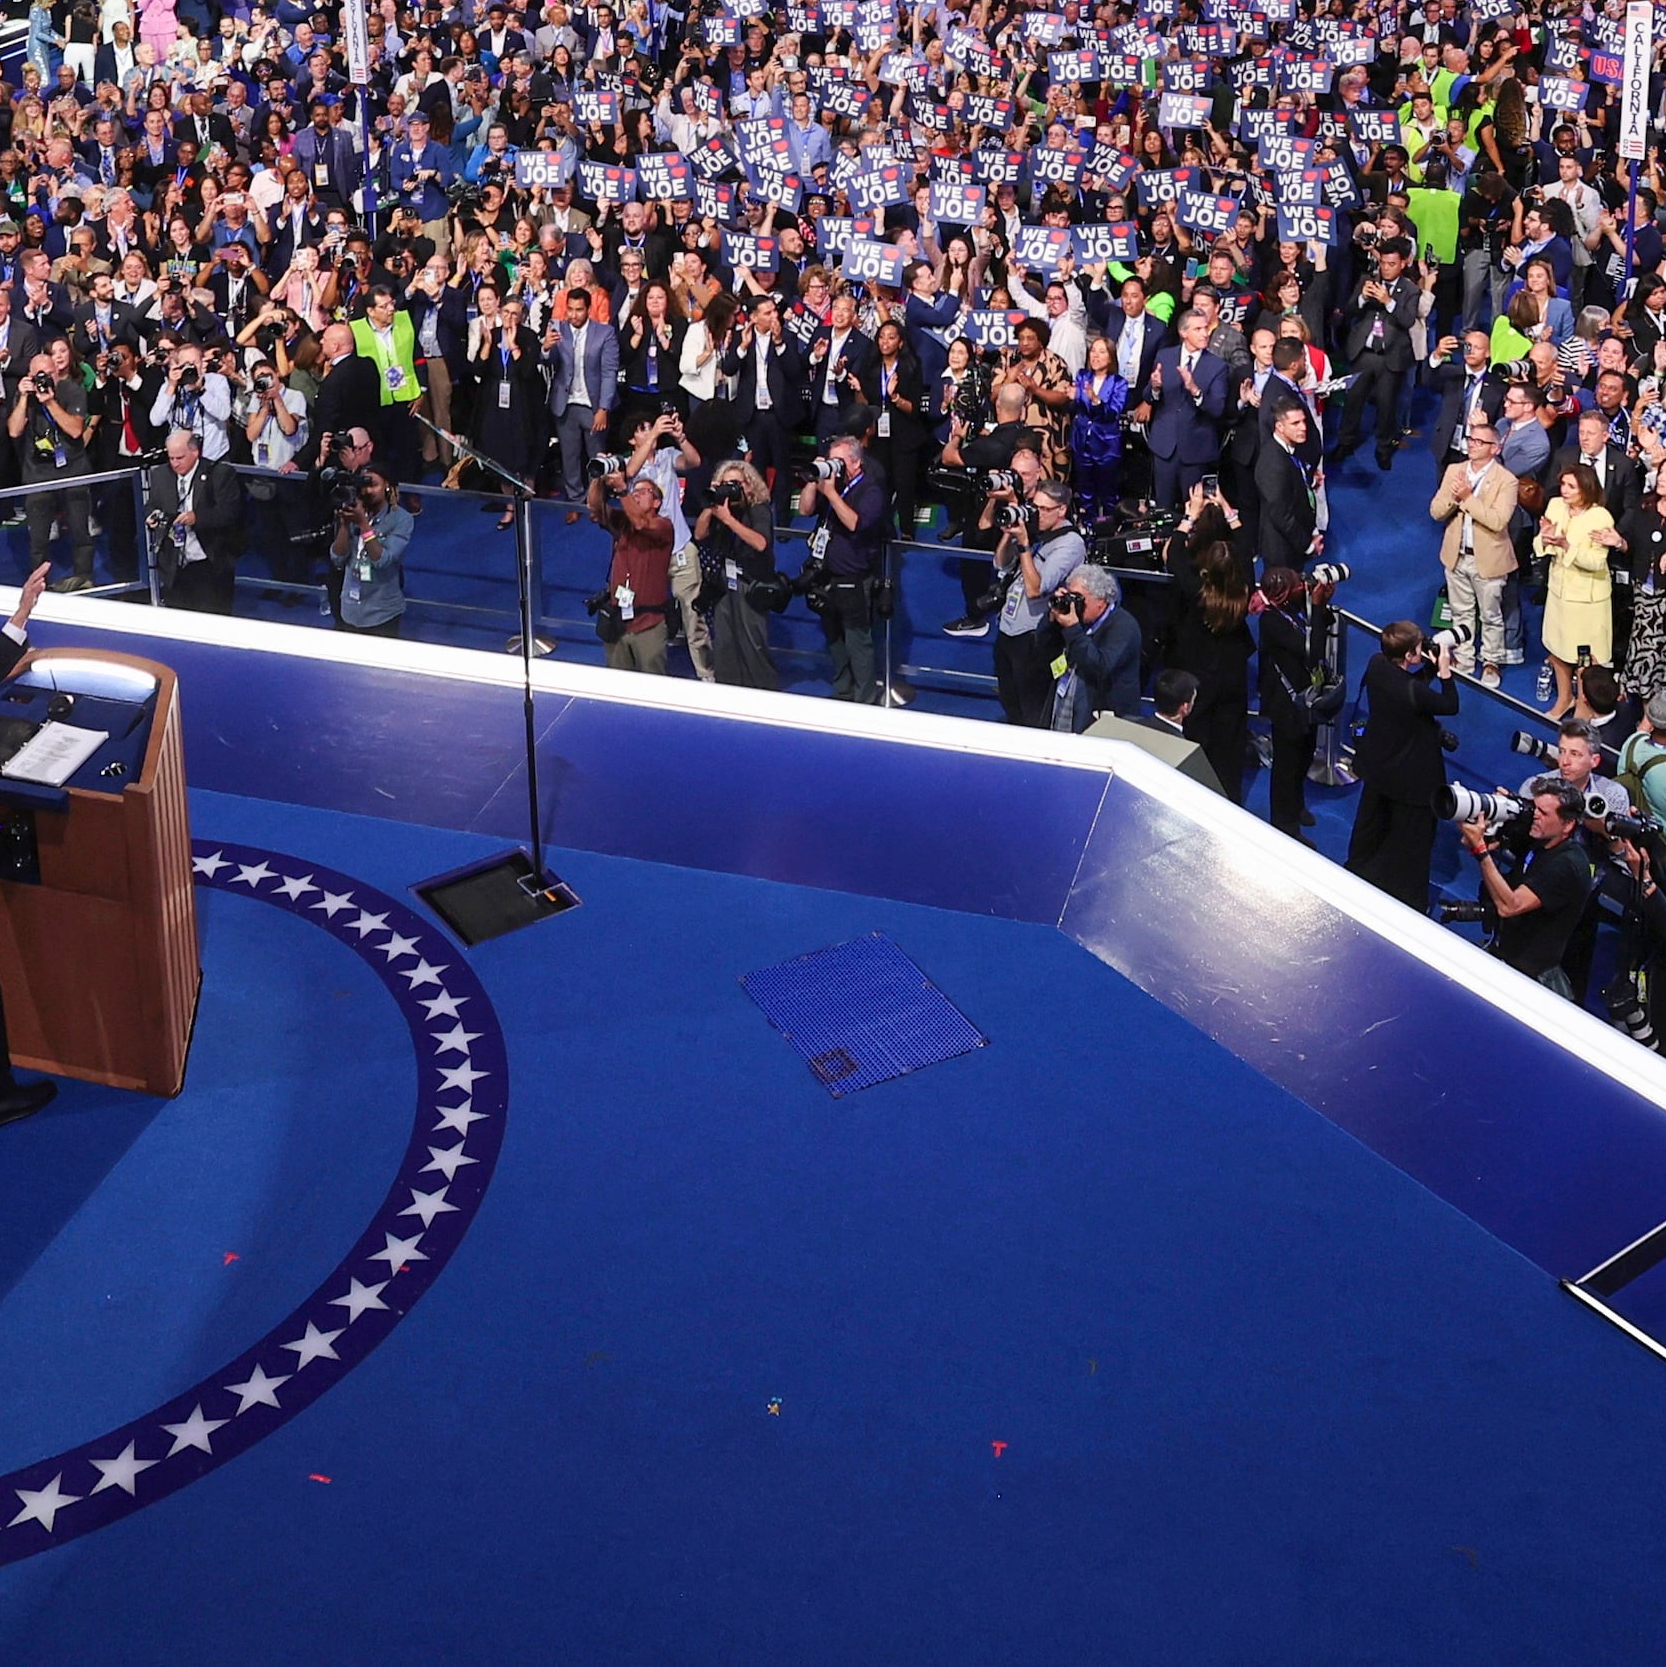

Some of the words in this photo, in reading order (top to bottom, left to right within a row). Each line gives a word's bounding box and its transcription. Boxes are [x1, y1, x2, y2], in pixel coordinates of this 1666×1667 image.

[1285, 62, 1312, 75] WE
[1286, 73, 1325, 90] JOE
[1542, 77, 1570, 91] WE
[1627, 22, 1647, 136] CALIFORNIA
[1540, 91, 1580, 109] JOE
[520, 153, 545, 167] WE
[519, 165, 560, 185] JOE
[850, 240, 881, 257] WE
[848, 257, 894, 281] JOE
